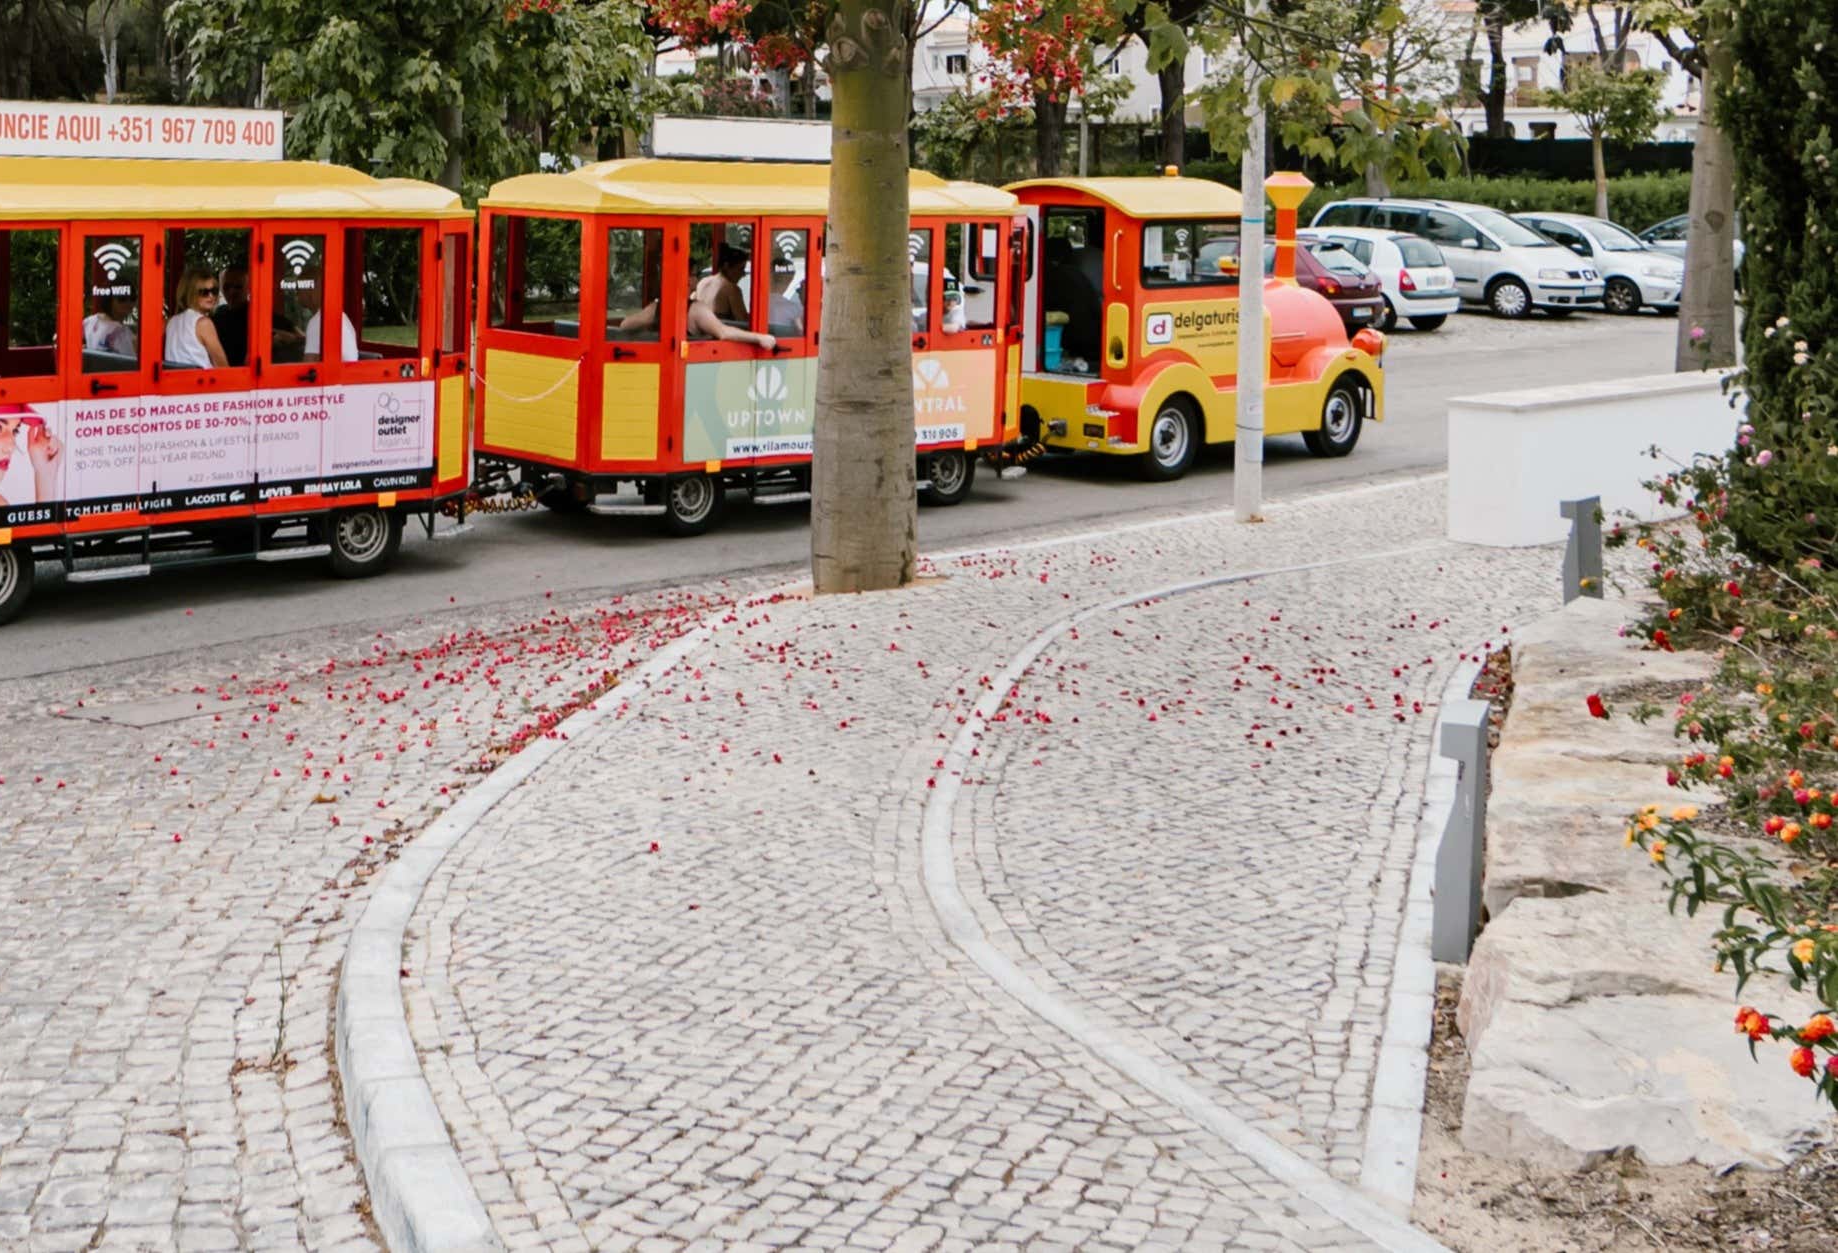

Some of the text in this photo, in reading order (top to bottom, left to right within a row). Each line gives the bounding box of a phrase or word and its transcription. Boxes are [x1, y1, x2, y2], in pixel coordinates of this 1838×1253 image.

[55, 115, 102, 142] AQUI
[107, 116, 153, 143] +351
[162, 117, 195, 144] 967
[202, 118, 236, 146] 709
[242, 120, 275, 147] 400
[92, 284, 131, 297] free WiFi
[280, 278, 315, 290] free WiFi
[1174, 307, 1240, 332] delgaturis
[75, 393, 345, 422] MAIS DE 50 MARCAS DE FASHION & LIFESTYLE
[727, 407, 807, 428] UPTOWN
[75, 425, 103, 439] COM
[106, 420, 182, 437] DESCONTOS
[185, 419, 202, 431] DE
[255, 412, 287, 425] TODO
[290, 411, 299, 423] O
[377, 414, 421, 426] designer
[377, 425, 407, 436] outlet
[74, 446, 104, 458] MORE
[107, 444, 136, 454] THAN
[154, 439, 198, 452] FASHION
[114, 456, 135, 468] OFF
[7, 508, 51, 523] GUESS
[66, 502, 109, 518] TOMMY
[124, 497, 173, 512] HILFIGER
[185, 492, 227, 506] LACOSTE
[340, 479, 362, 491] LOLA
[373, 476, 398, 488] CALVIN
[398, 475, 417, 486] KLEIN
